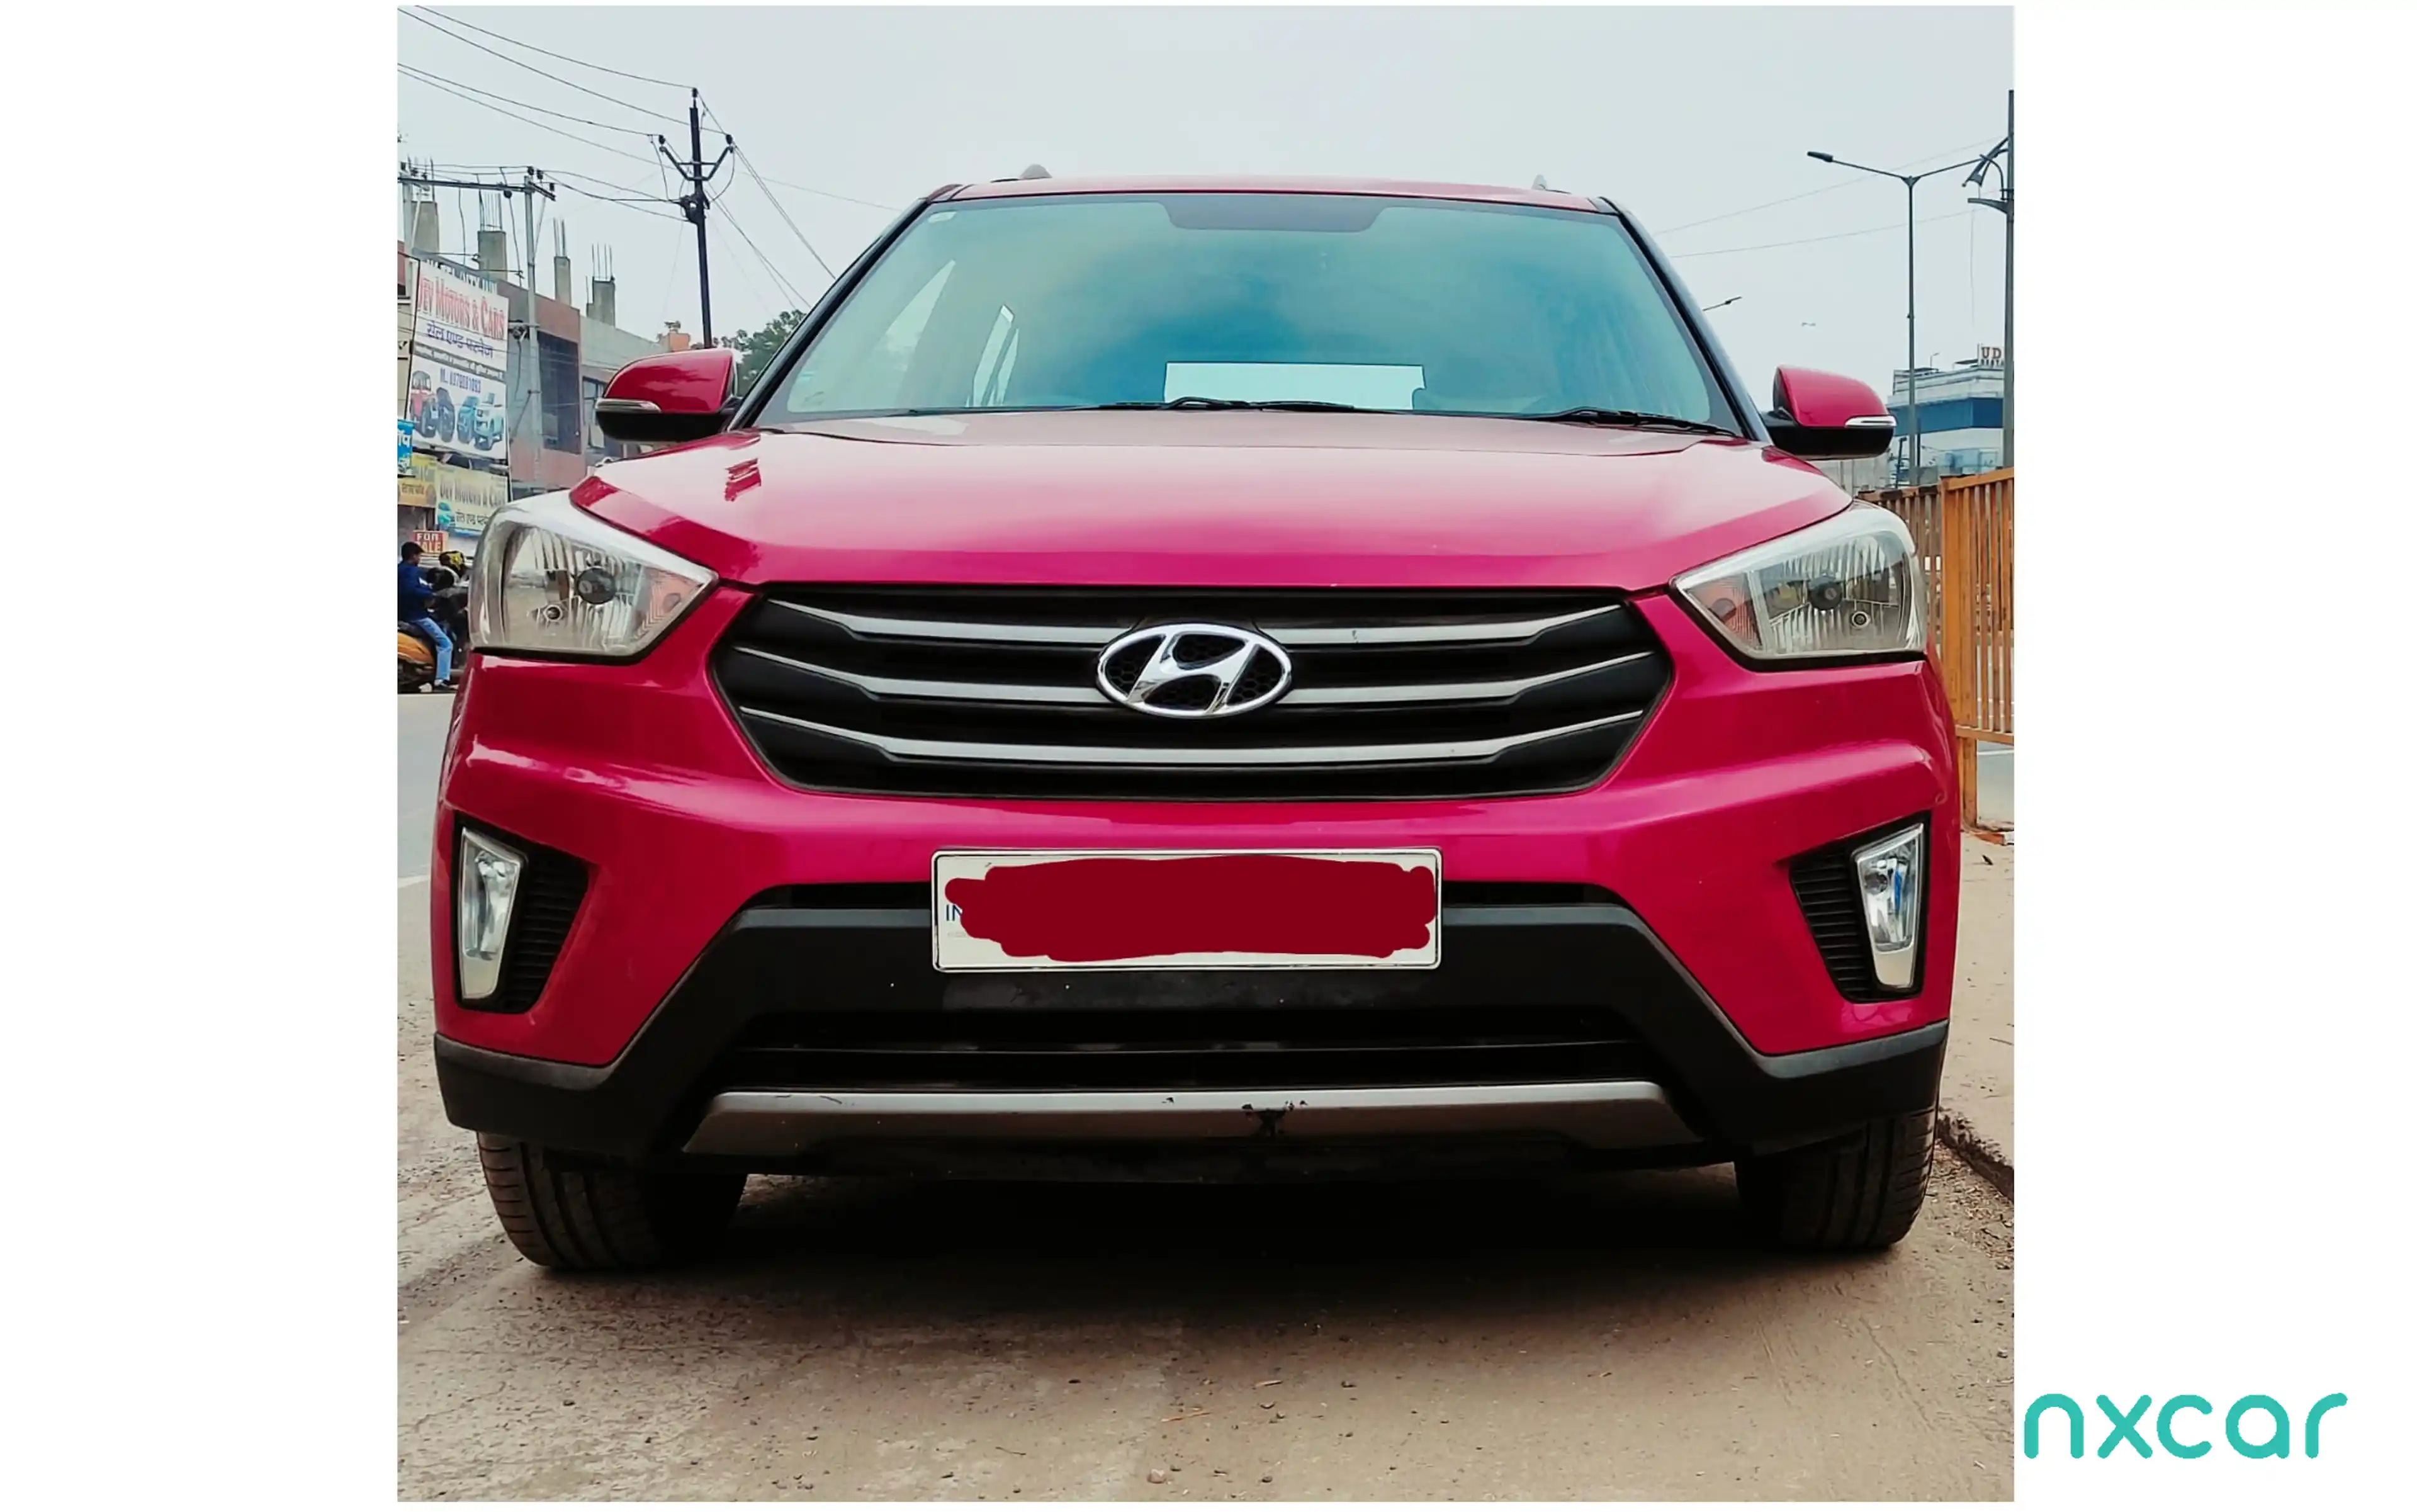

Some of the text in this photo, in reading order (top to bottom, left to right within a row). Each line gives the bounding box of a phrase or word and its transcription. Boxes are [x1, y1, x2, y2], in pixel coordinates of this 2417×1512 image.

[417, 533, 439, 541] FOR
[418, 541, 442, 552] ALE
[946, 904, 962, 921] IN
